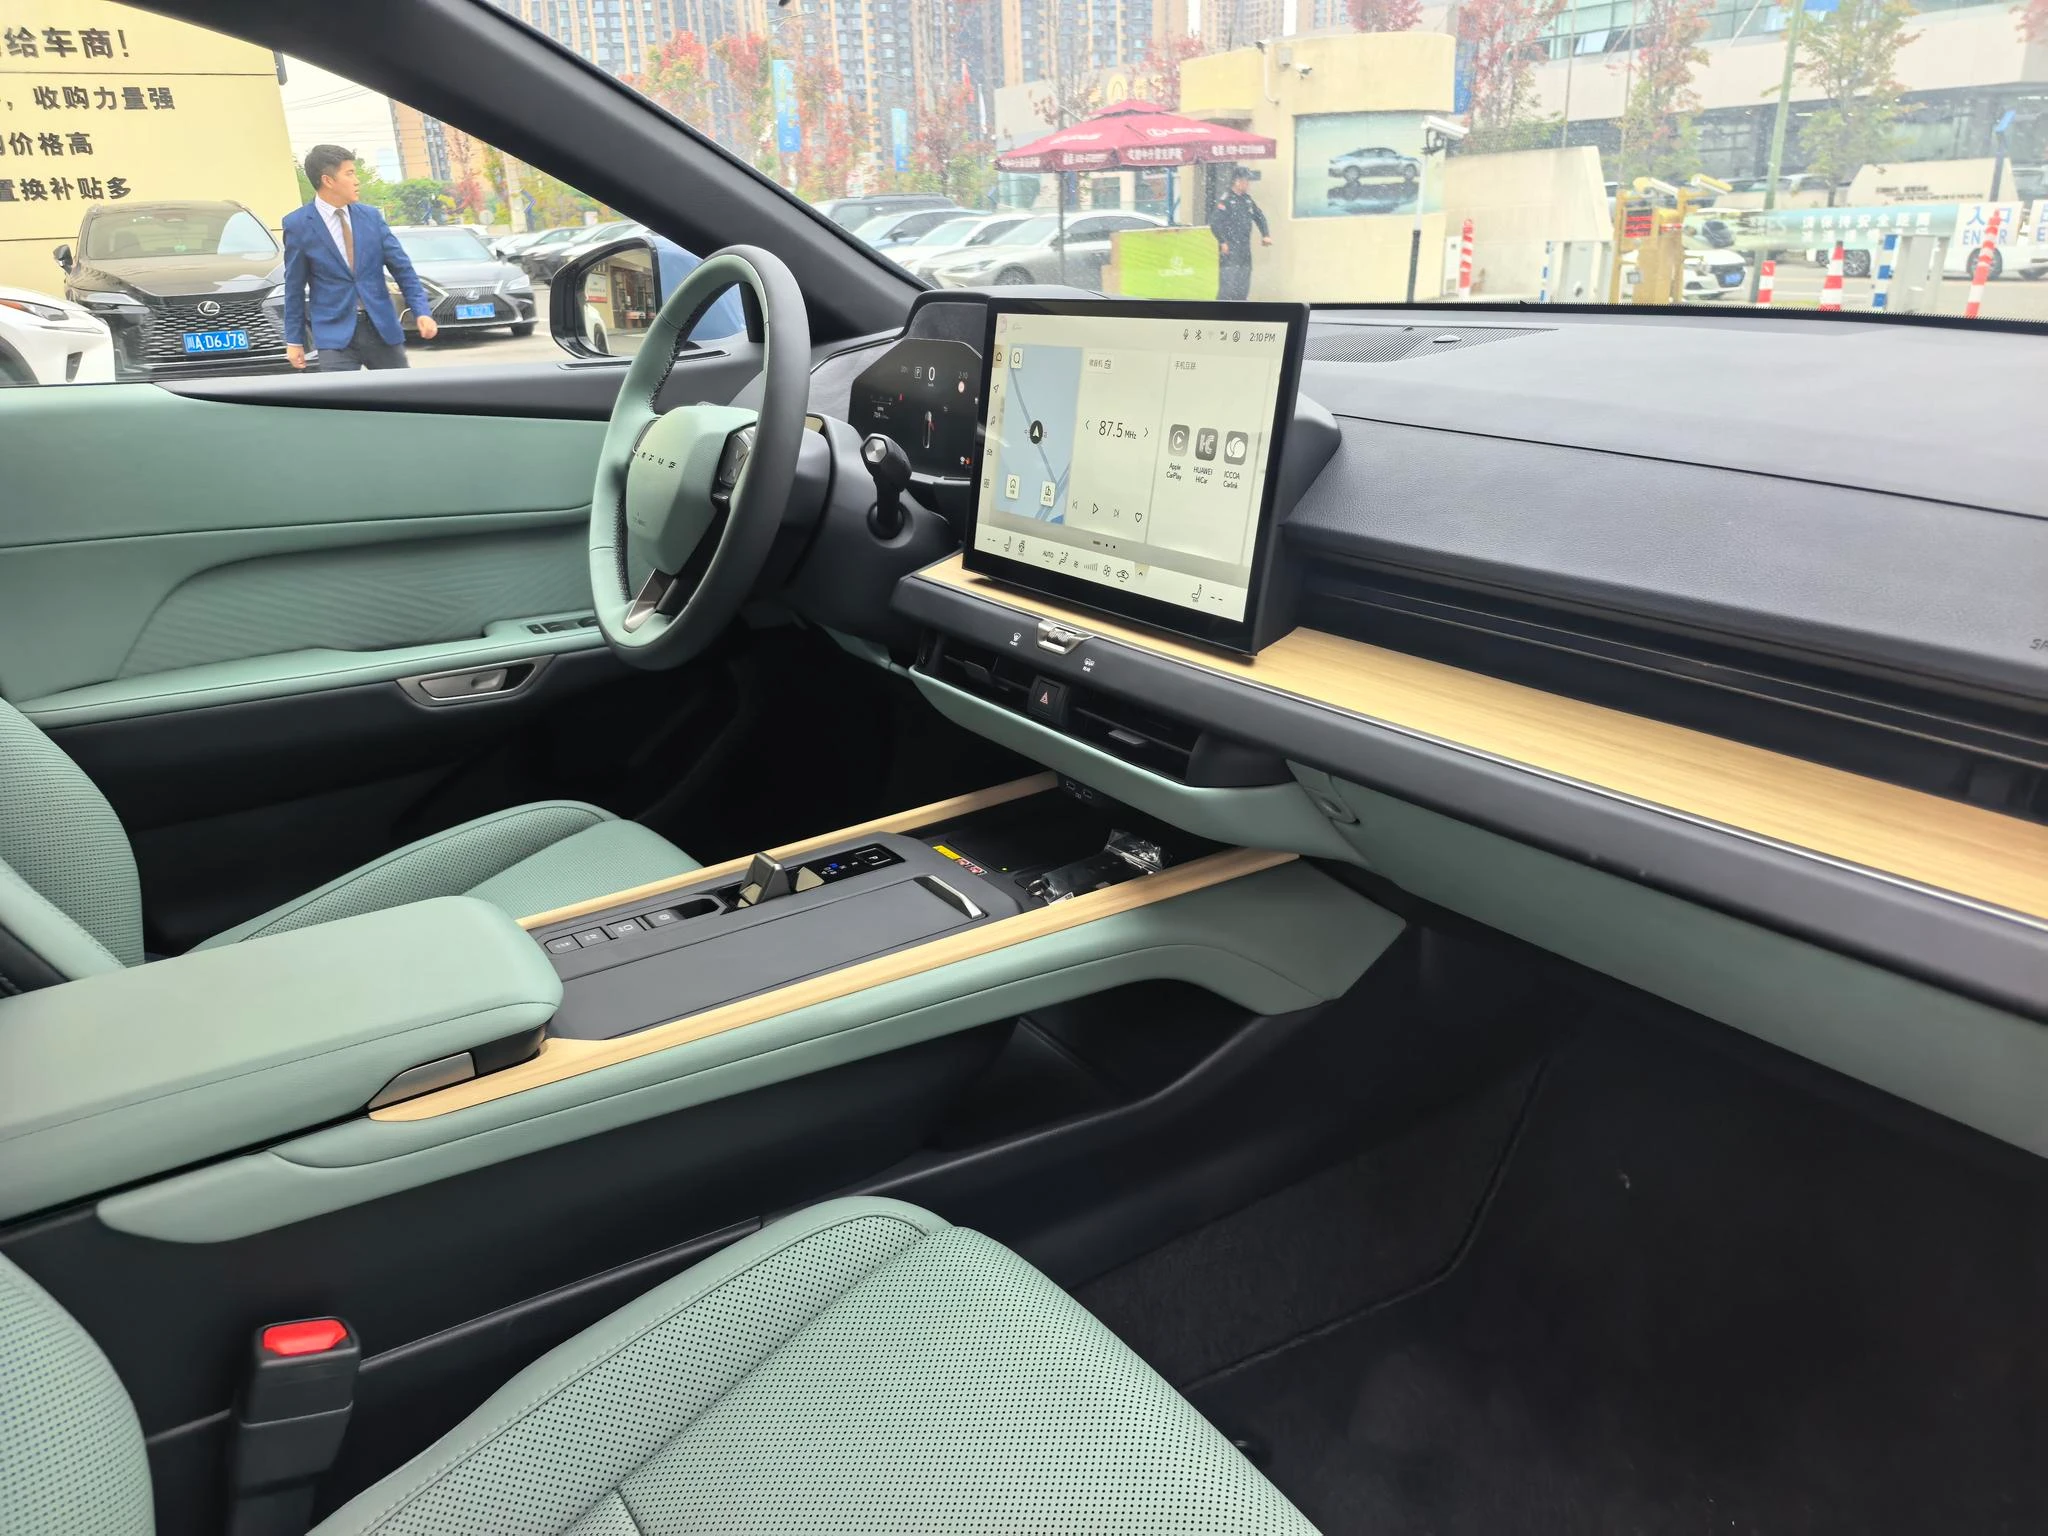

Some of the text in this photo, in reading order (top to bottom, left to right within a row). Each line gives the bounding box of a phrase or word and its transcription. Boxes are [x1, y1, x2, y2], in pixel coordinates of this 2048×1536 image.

[0, 132, 94, 156] 价格高
[1963, 228, 2008, 246] ENR
[1264, 333, 1276, 343] PM
[1098, 420, 1137, 440] 87.5 MHz
[1193, 466, 1214, 476] HUAWEI
